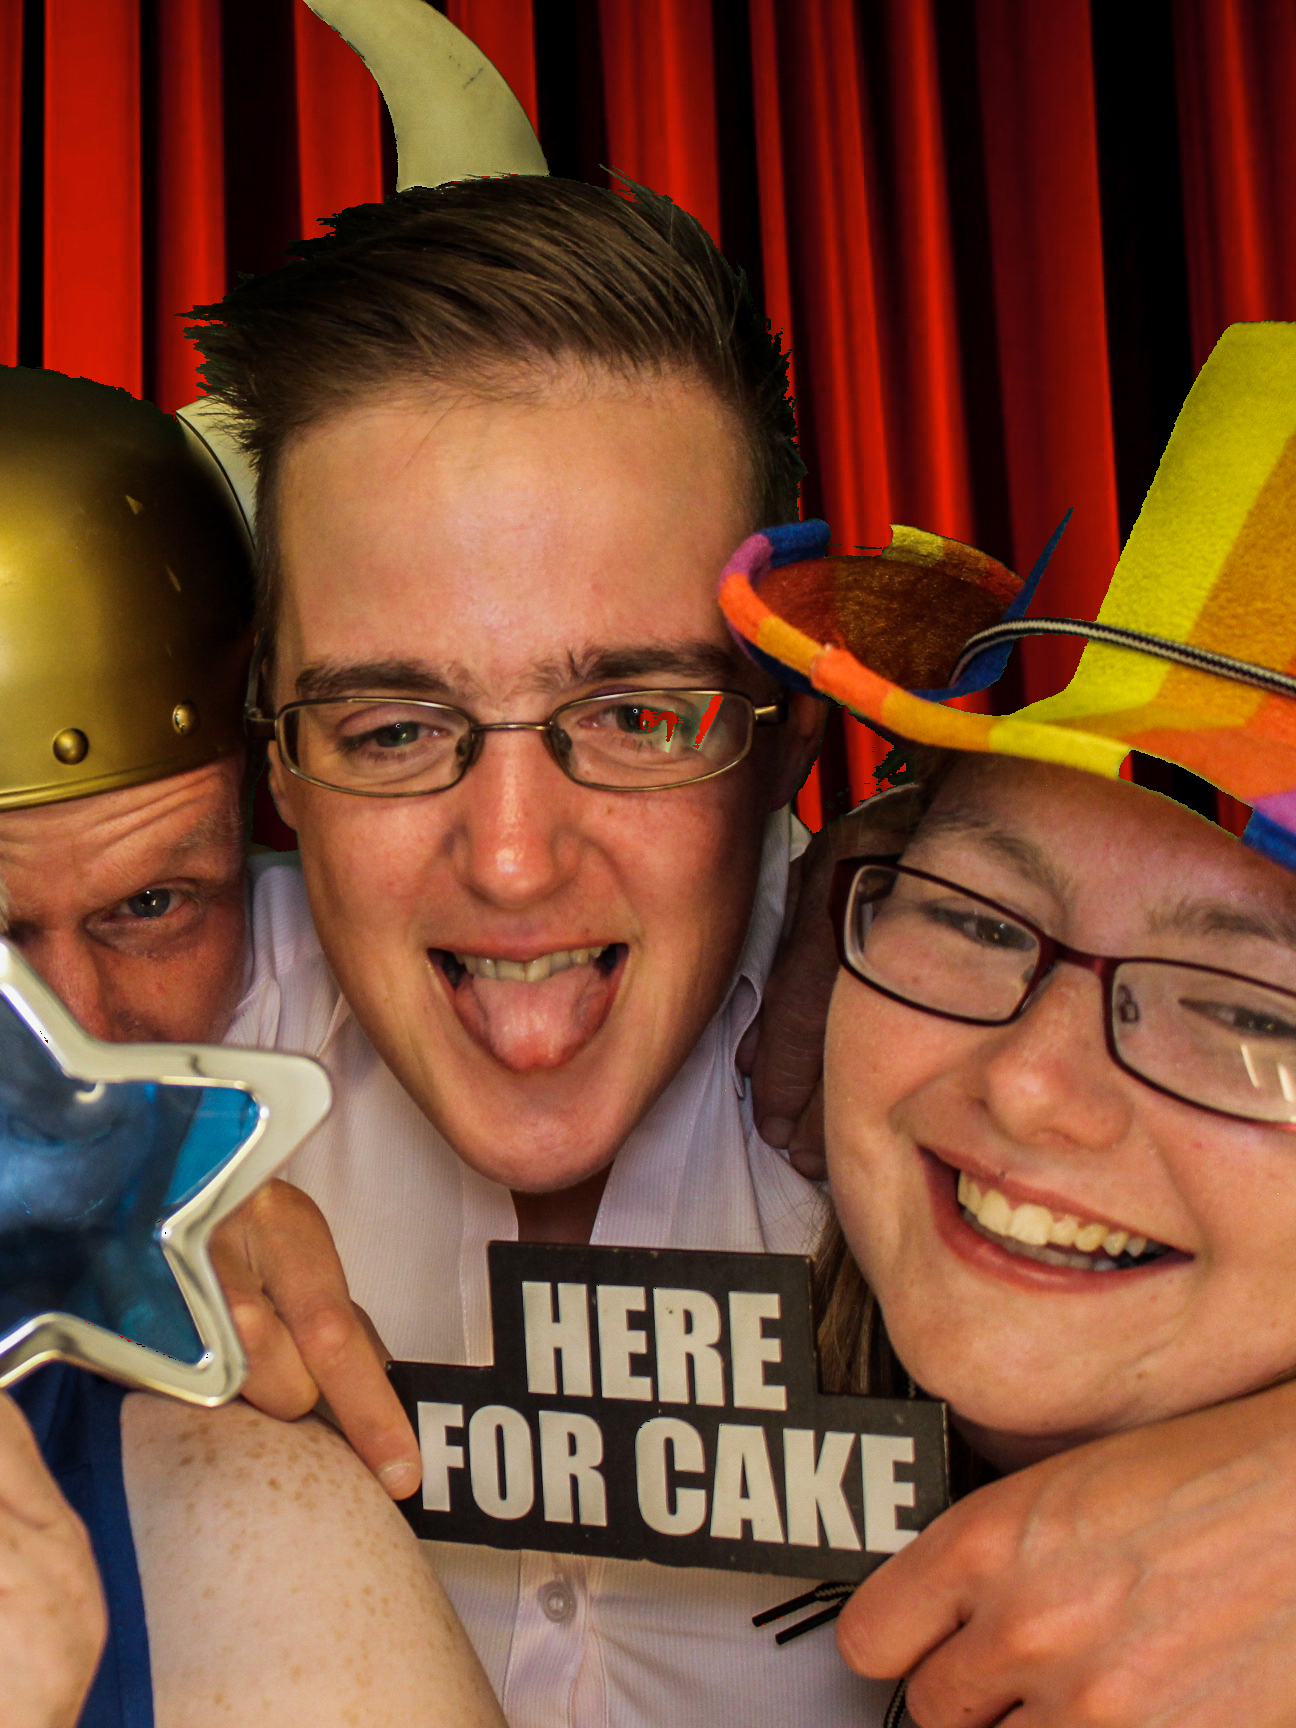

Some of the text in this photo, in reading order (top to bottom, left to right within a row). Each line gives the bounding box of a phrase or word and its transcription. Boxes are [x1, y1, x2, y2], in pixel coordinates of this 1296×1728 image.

[521, 1280, 787, 1411] HERE
[416, 1401, 919, 1553] FOR CAKE
